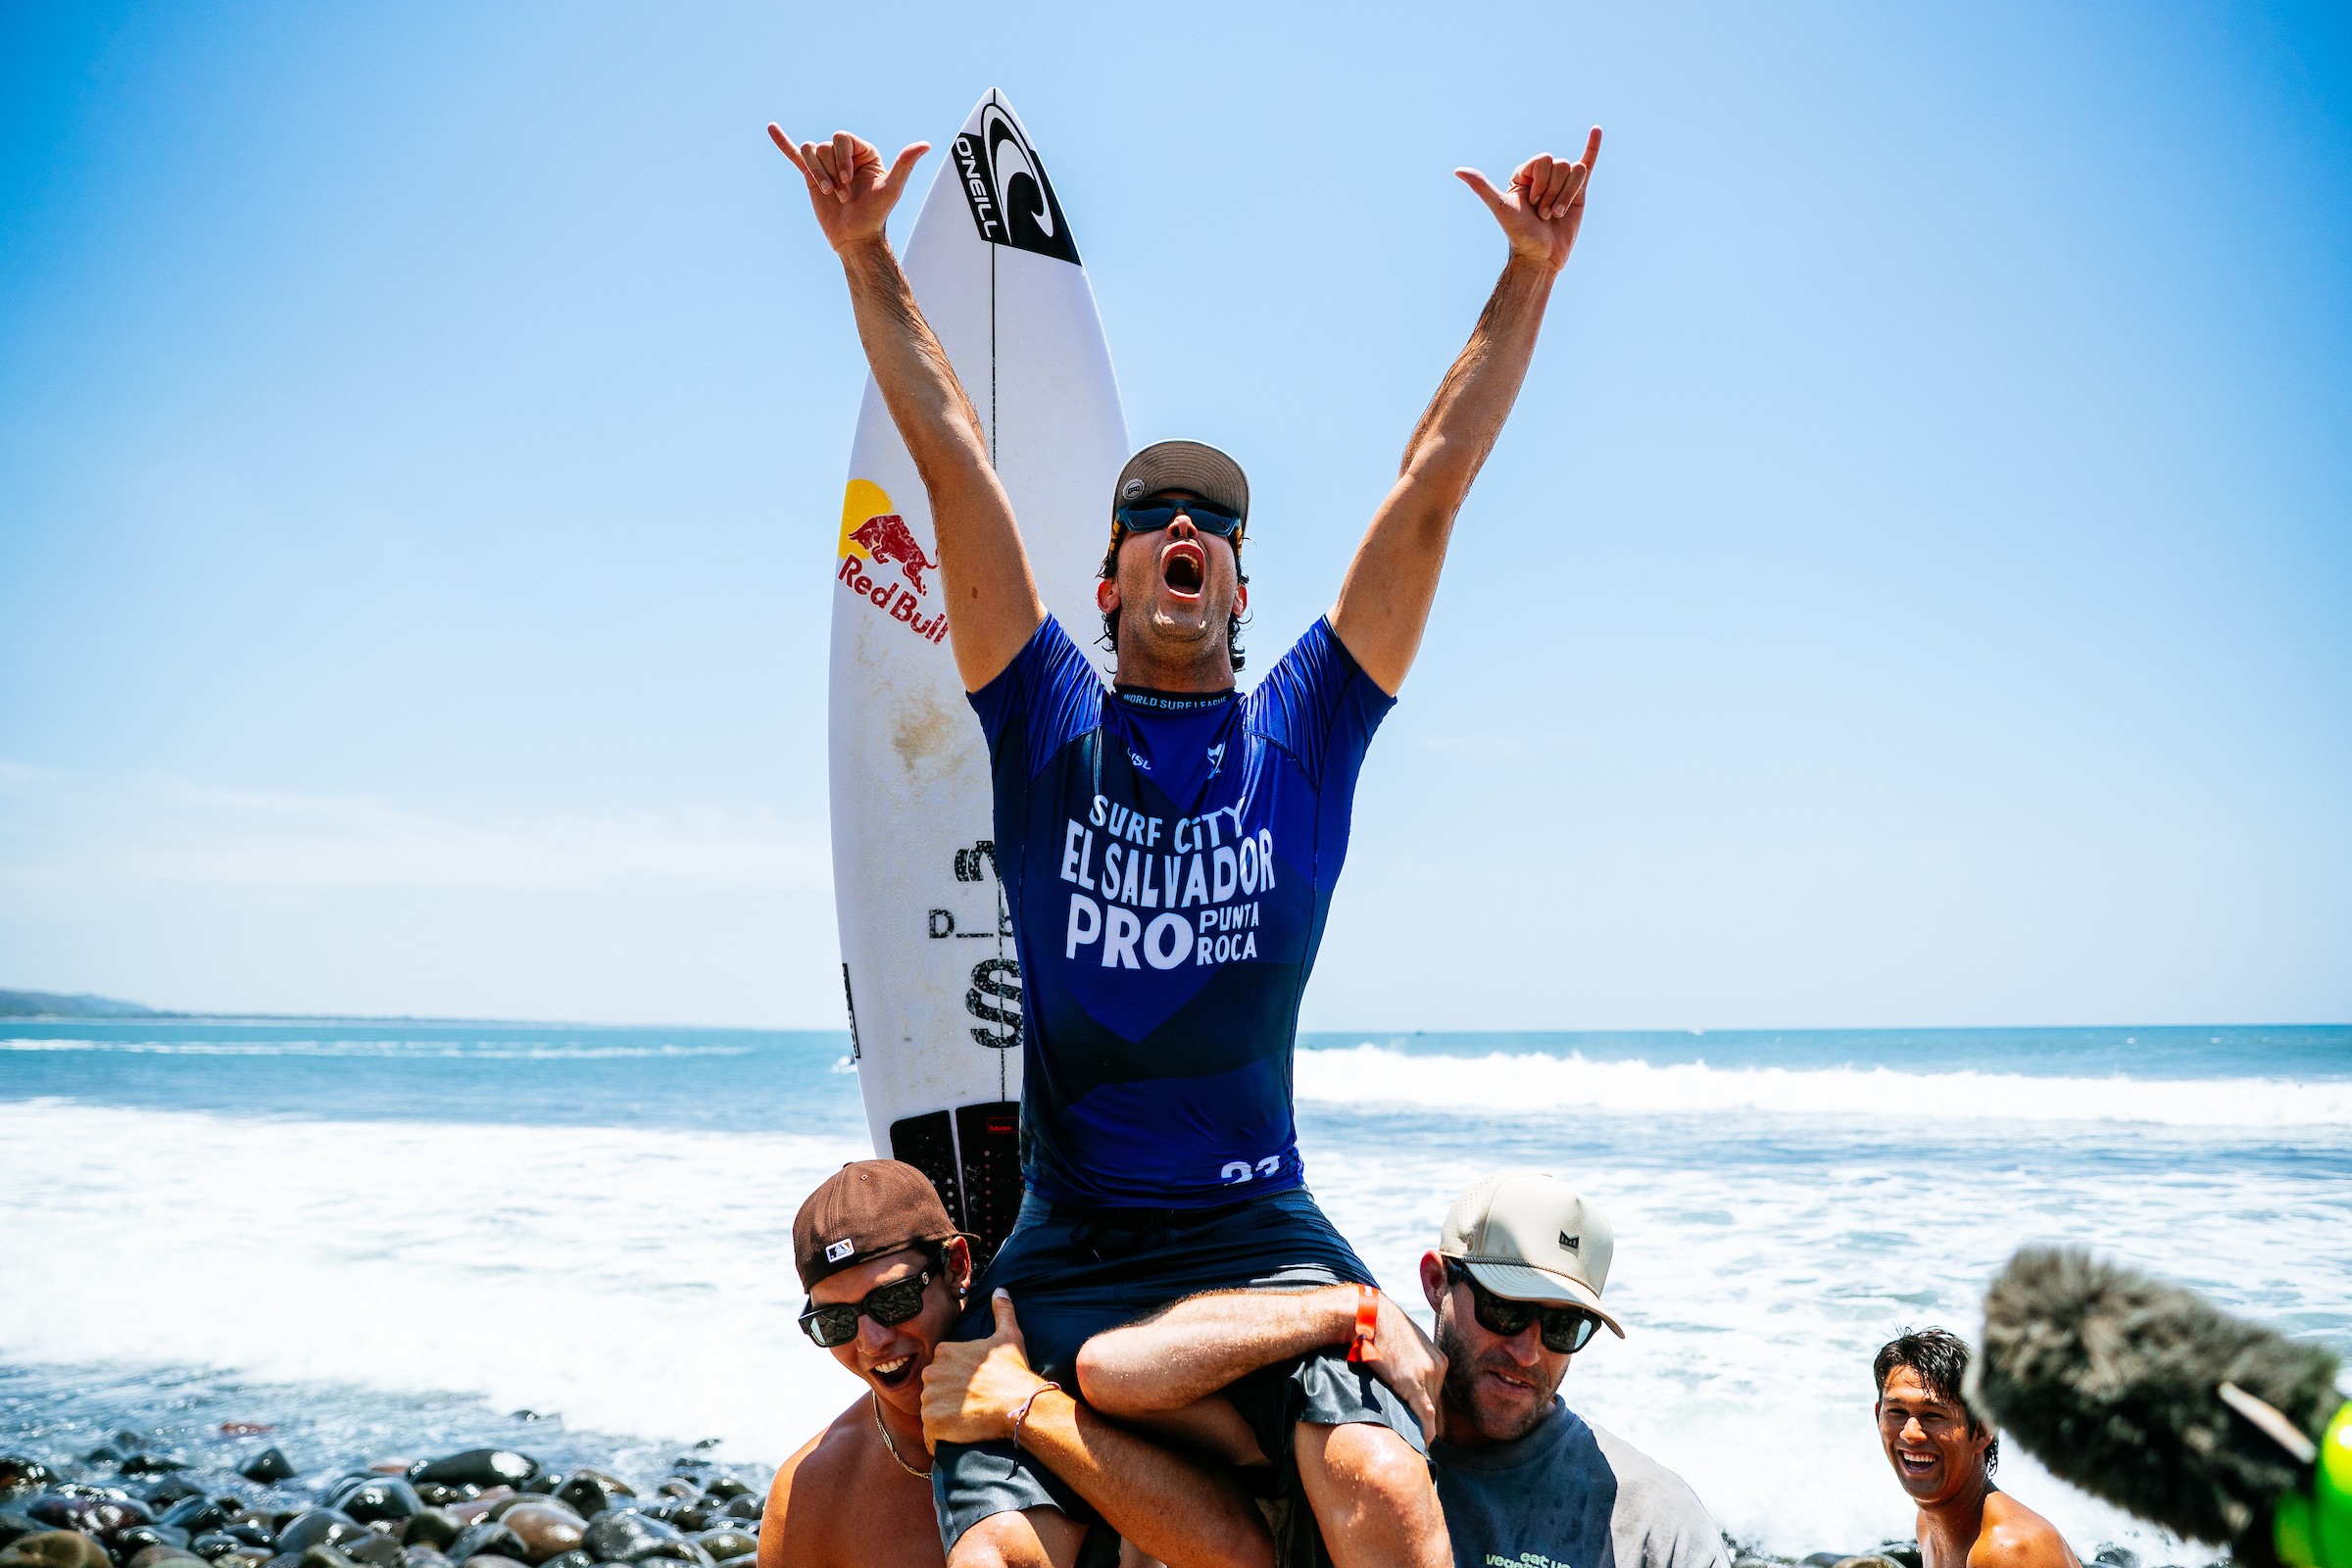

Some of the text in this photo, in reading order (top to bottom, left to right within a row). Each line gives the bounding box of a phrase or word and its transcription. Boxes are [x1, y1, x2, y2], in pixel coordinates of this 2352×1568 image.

[956, 137, 998, 238] O'NEILL
[838, 554, 949, 646] Red Bull
[1123, 693, 1157, 707] WORLD
[1159, 699, 1192, 710] SURF
[1089, 794, 1163, 848] SURF
[1059, 817, 1276, 908] EL SALVADOR
[1065, 893, 1194, 970] PRO
[1196, 931, 1257, 966] ROCA
[1199, 901, 1259, 934] PUNTA
